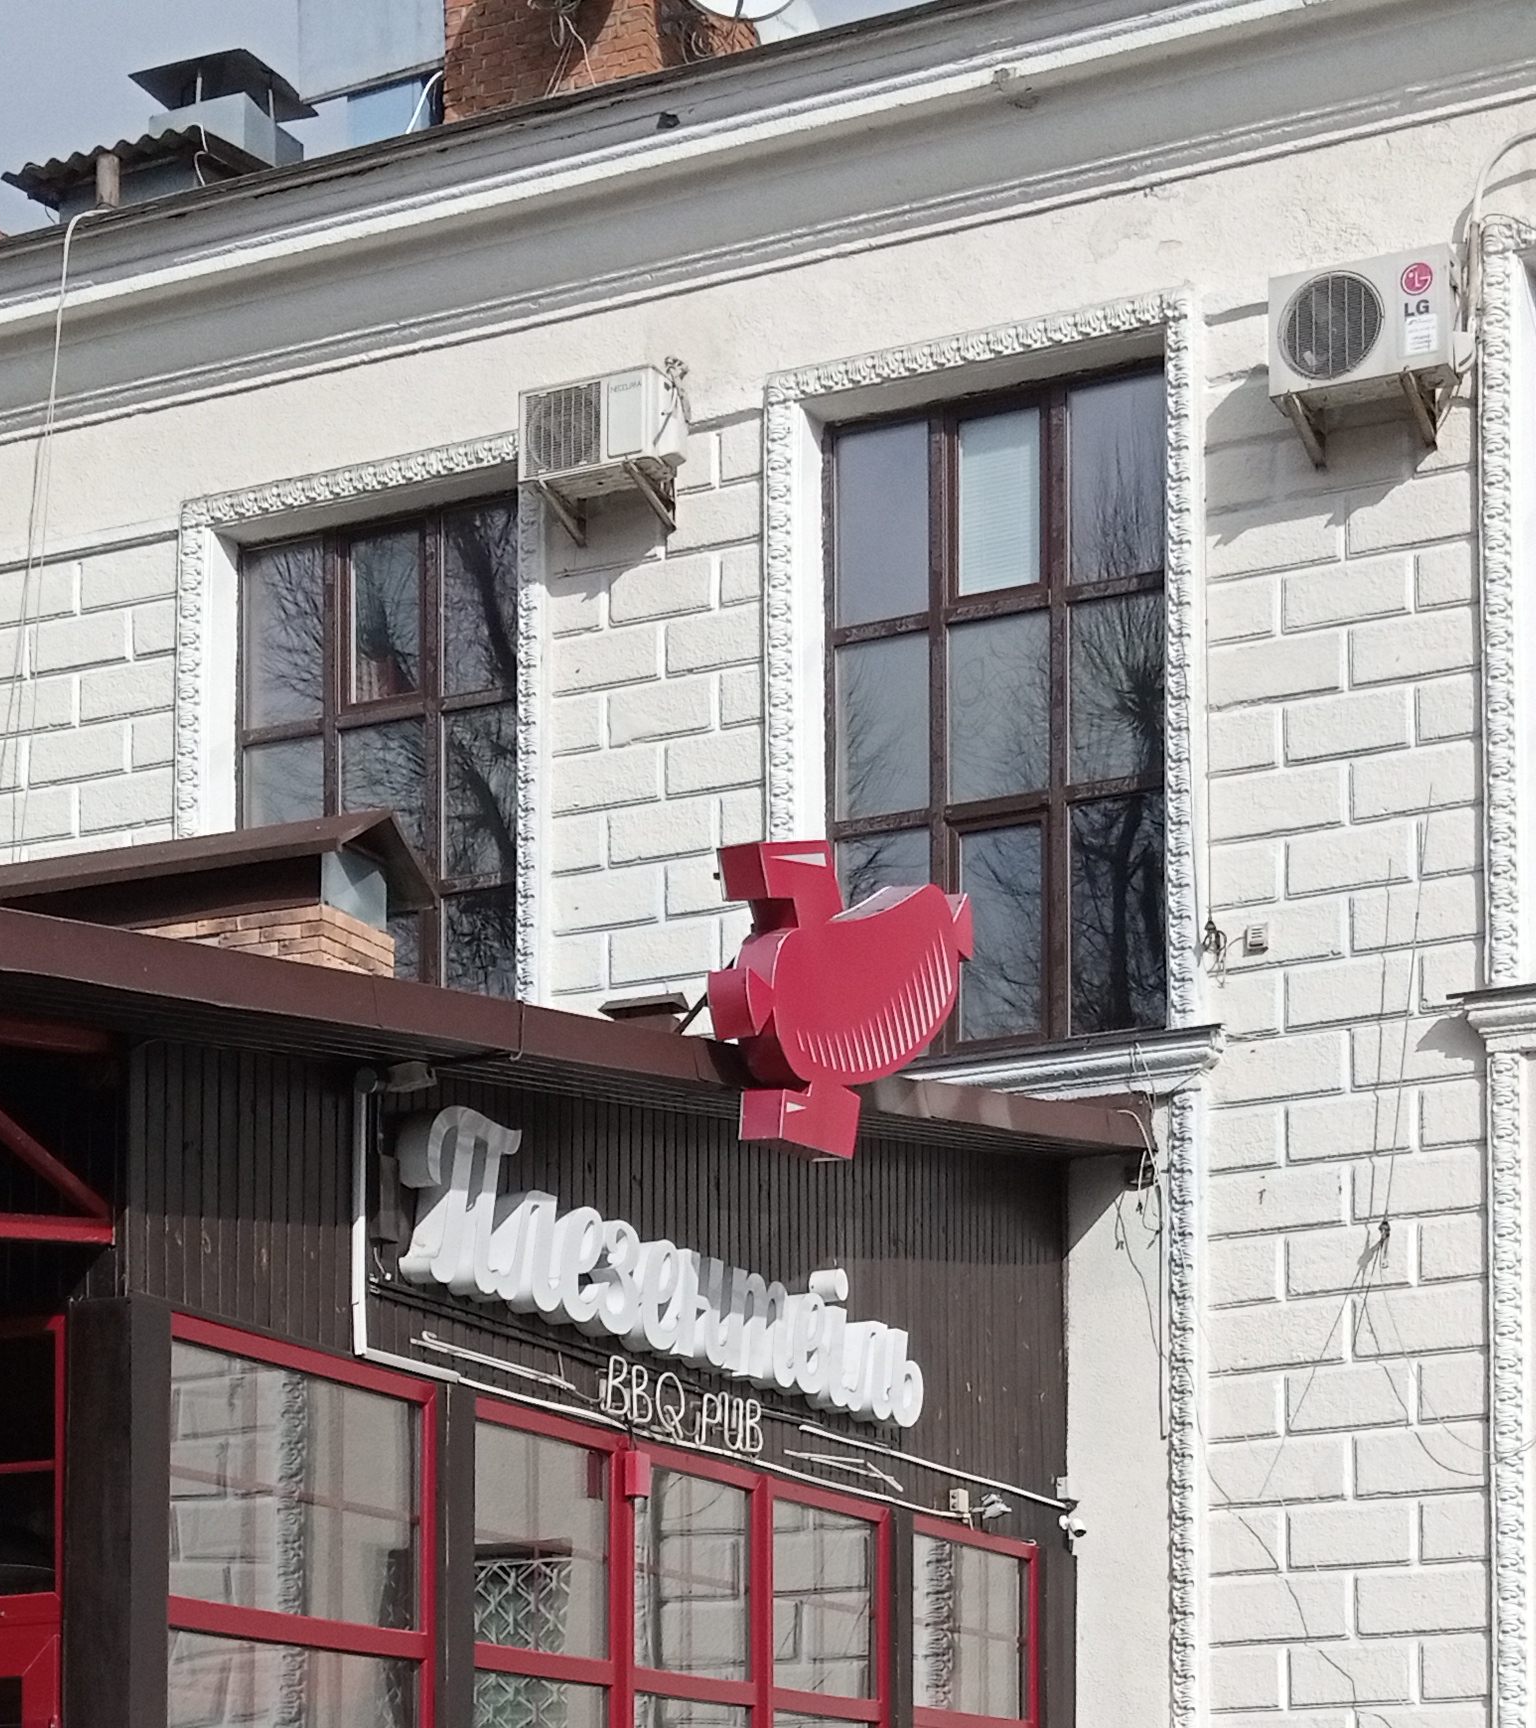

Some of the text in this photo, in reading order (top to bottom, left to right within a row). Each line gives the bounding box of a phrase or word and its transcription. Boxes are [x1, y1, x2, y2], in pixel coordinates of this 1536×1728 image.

[1404, 299, 1430, 318] LG
[600, 1355, 763, 1452] BBQ PUB
